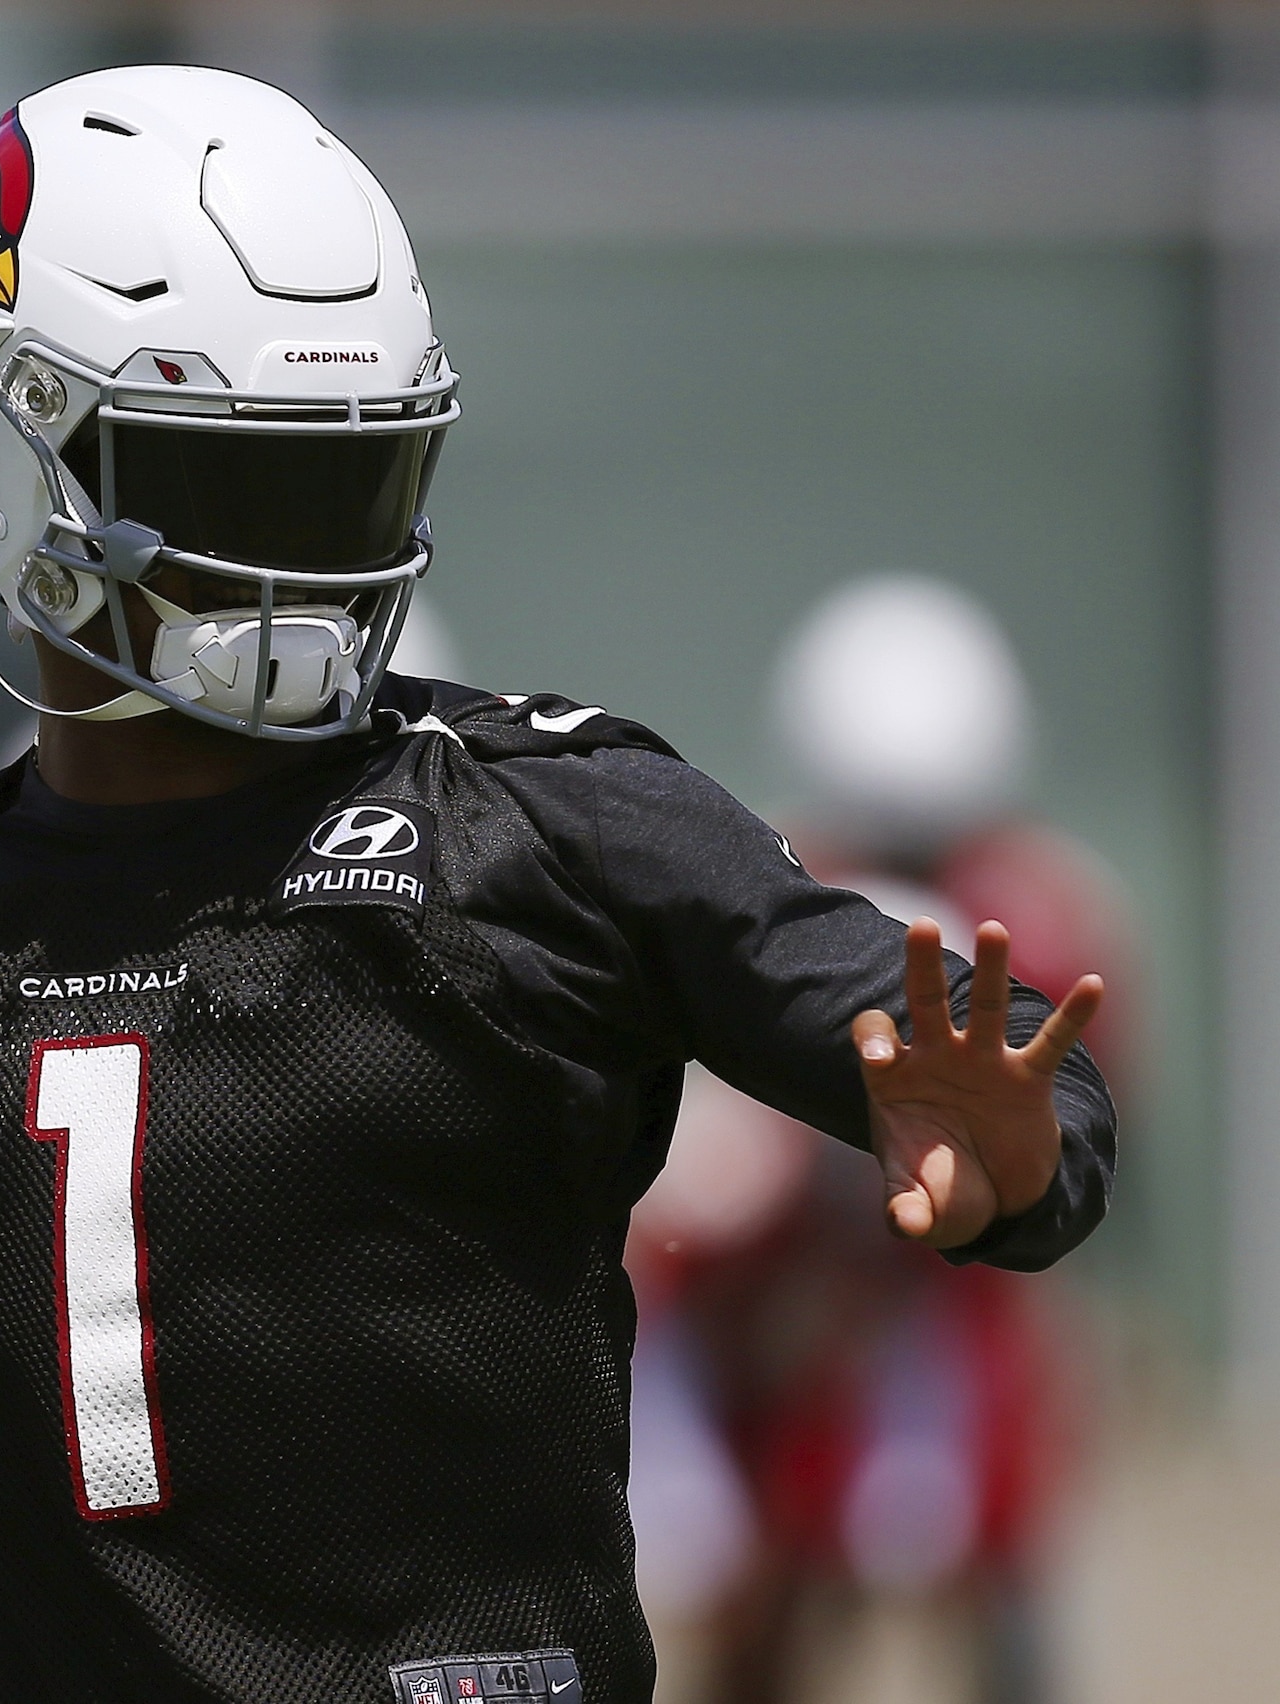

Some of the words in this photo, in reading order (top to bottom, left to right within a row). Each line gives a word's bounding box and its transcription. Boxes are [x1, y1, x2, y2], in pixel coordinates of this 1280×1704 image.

[284, 352, 379, 363] CARDINALS
[282, 868, 424, 904] HYUNDAI
[19, 963, 188, 999] CARDINALS
[25, 1034, 172, 1520] 1
[496, 1665, 531, 1690] 46
